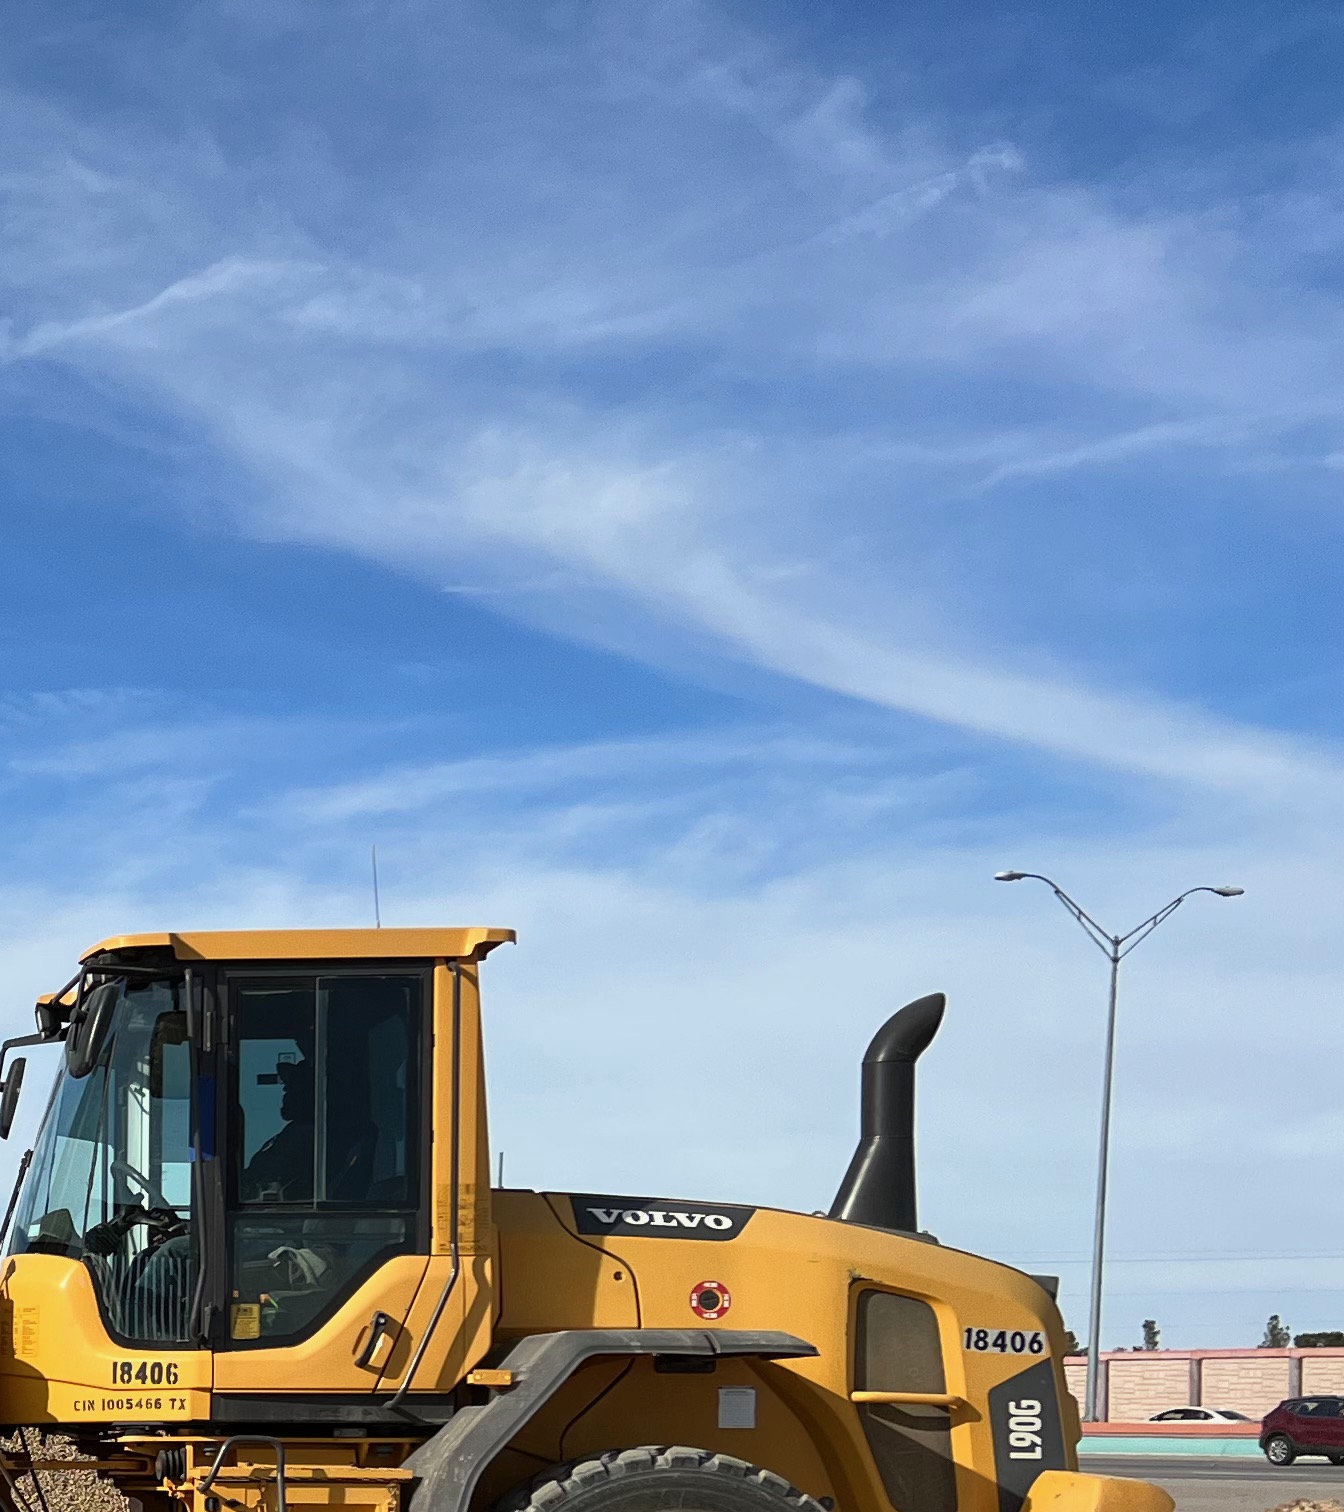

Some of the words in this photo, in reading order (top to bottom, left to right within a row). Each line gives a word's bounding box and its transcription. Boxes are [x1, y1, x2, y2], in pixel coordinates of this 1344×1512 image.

[587, 1208, 733, 1230] VOLVO
[965, 1327, 1043, 1354] 18406
[112, 1361, 178, 1385] 18406
[74, 1400, 95, 1411] CIN
[101, 1398, 162, 1411] 1005466
[169, 1398, 187, 1411] TX
[1008, 1399, 1042, 1460] L90G
